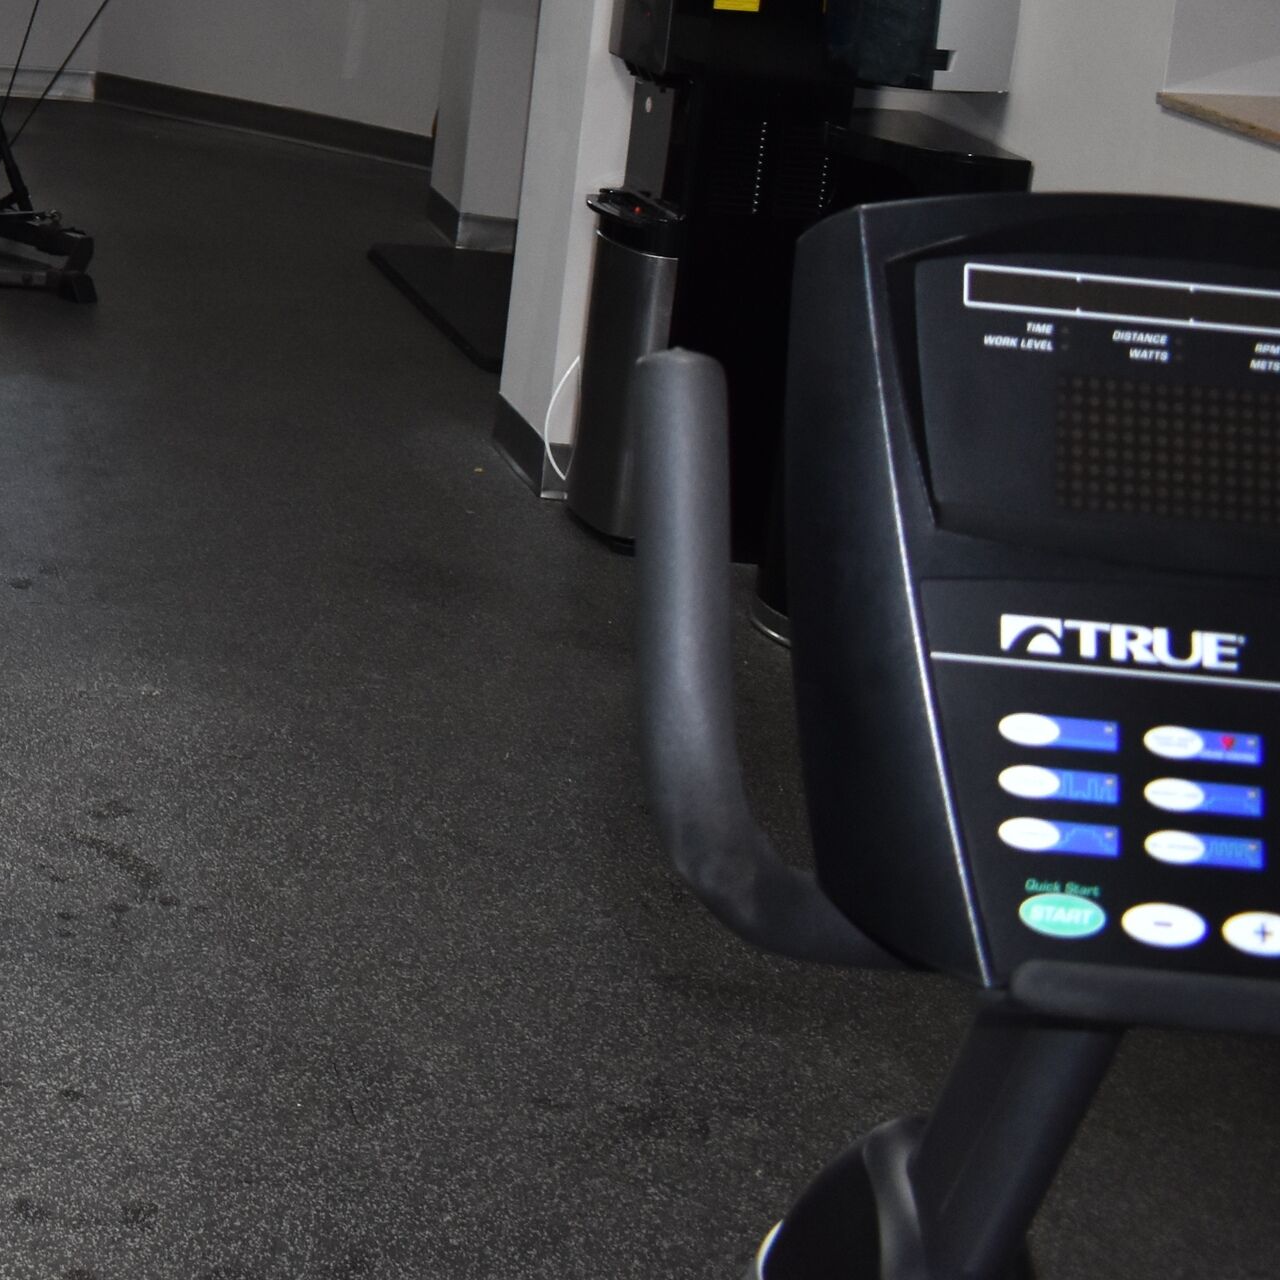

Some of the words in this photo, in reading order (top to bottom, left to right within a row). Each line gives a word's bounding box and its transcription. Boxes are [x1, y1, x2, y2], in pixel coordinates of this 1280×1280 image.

[1025, 321, 1054, 335] TIME
[983, 334, 1018, 348] WORK
[1020, 337, 1054, 352] LEVEL
[1112, 330, 1169, 345] DISTANCE
[1129, 347, 1171, 362] WATTS
[1249, 359, 1280, 372] METS
[1063, 619, 1241, 671] TRUE
[1024, 878, 1062, 893] Quick
[1065, 880, 1101, 898] Start
[1029, 903, 1095, 924] START
